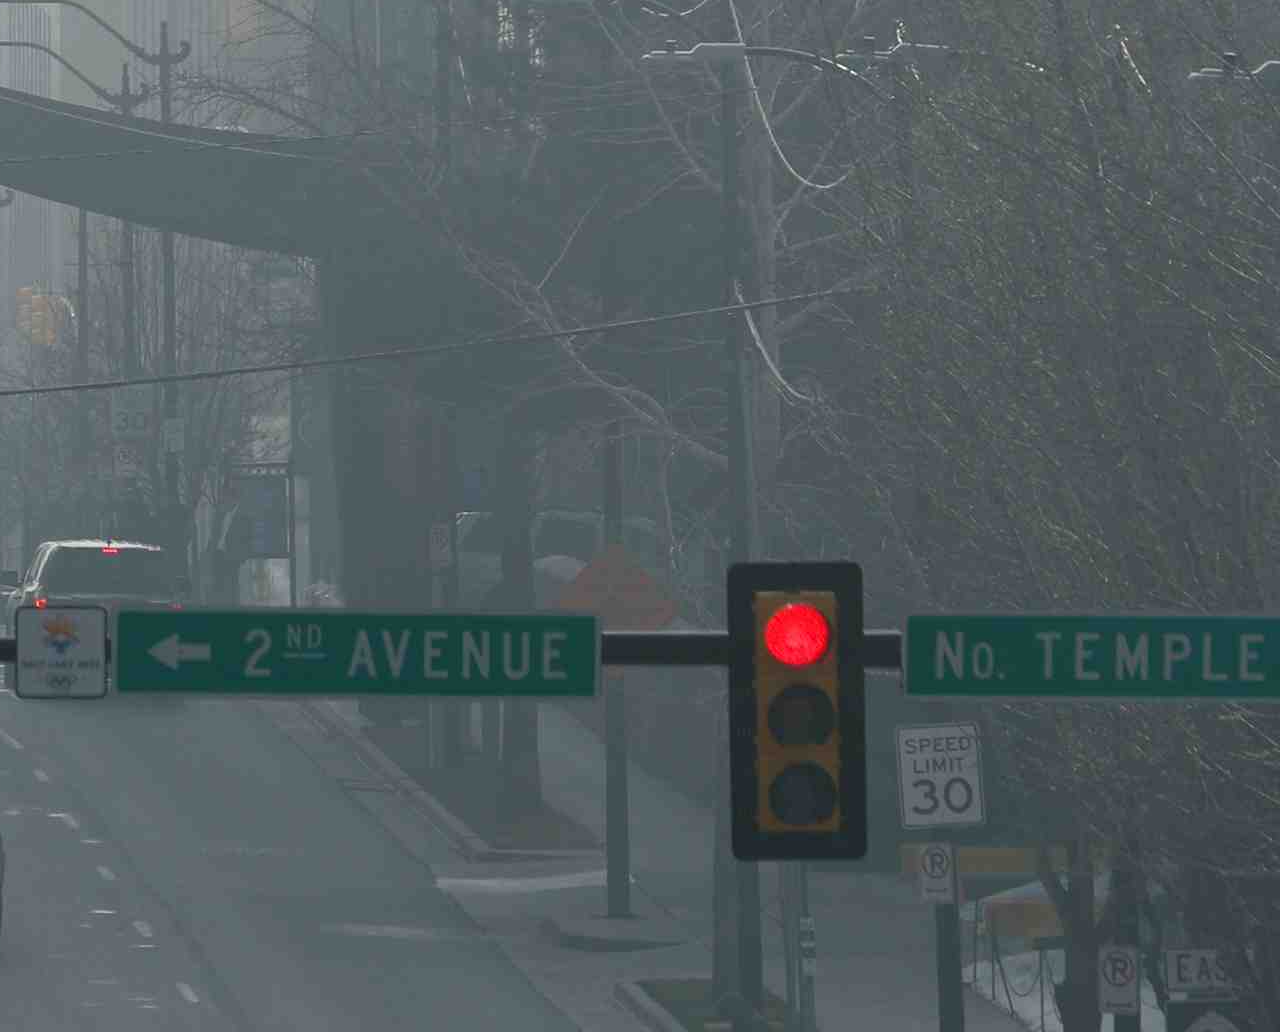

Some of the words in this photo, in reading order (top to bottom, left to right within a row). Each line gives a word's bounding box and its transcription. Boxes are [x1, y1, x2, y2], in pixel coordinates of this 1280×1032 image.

[346, 629, 569, 681] AVENUE
[933, 630, 1006, 681] No.
[1035, 632, 1267, 682] TEMPLE
[904, 734, 972, 755] SPEED
[912, 757, 966, 774] LIMIT
[911, 776, 973, 815] 30
[1175, 952, 1235, 984] EAS
